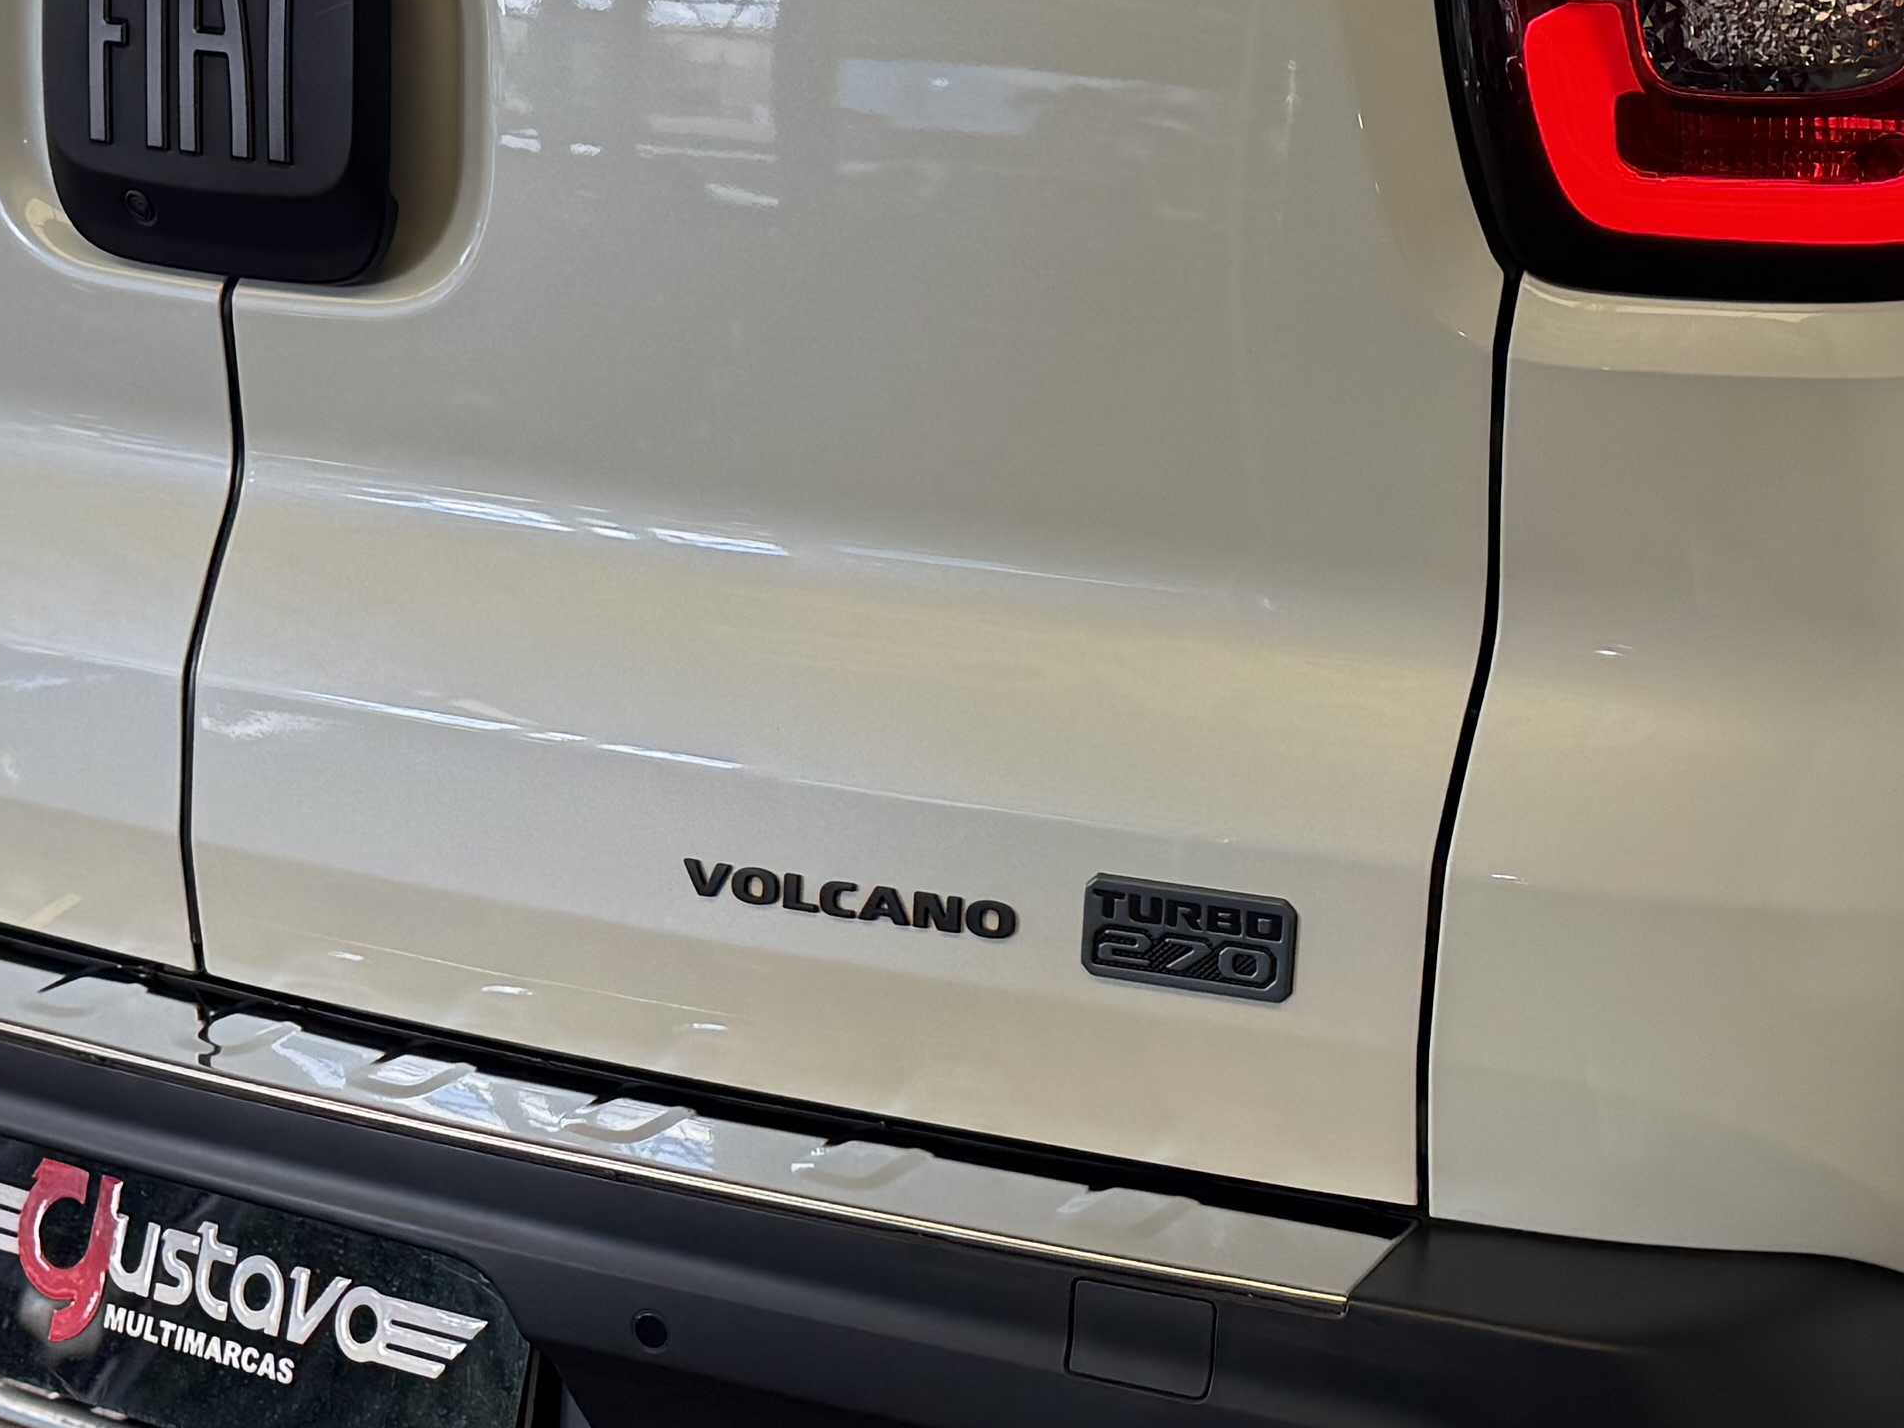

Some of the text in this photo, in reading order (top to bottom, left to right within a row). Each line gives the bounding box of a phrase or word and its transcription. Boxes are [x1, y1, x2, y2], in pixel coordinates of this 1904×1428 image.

[683, 858, 1017, 940] VOLCANO
[1092, 888, 1283, 942] TURBO
[1097, 928, 1272, 983] 270
[103, 1303, 295, 1385] MULTIMARCAS
